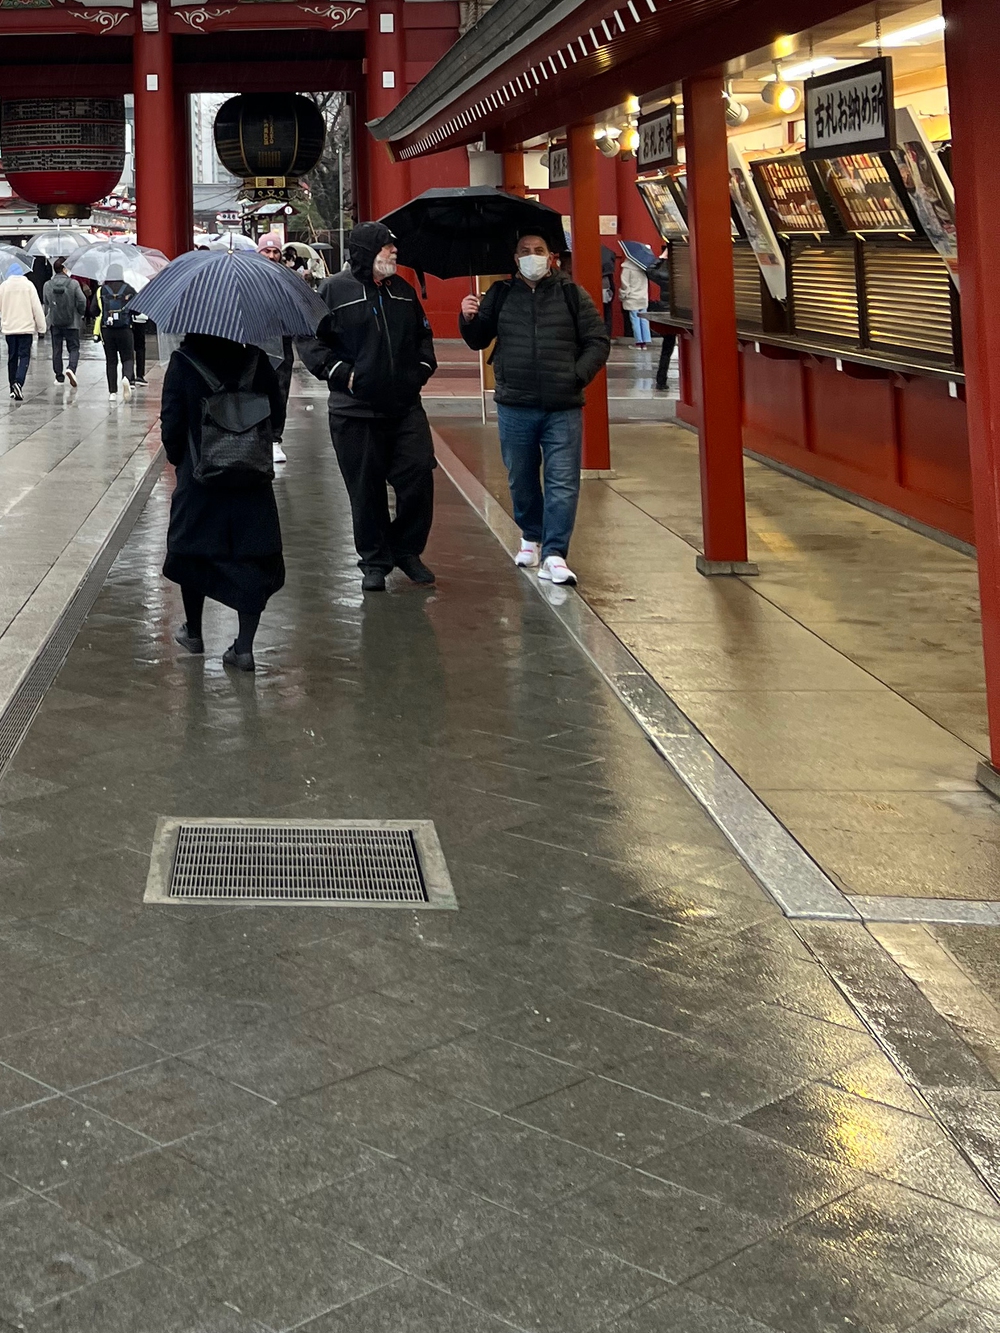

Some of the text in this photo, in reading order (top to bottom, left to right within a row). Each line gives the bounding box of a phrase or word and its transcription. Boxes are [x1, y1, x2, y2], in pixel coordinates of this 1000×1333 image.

[814, 82, 885, 140] 古札お納め所
